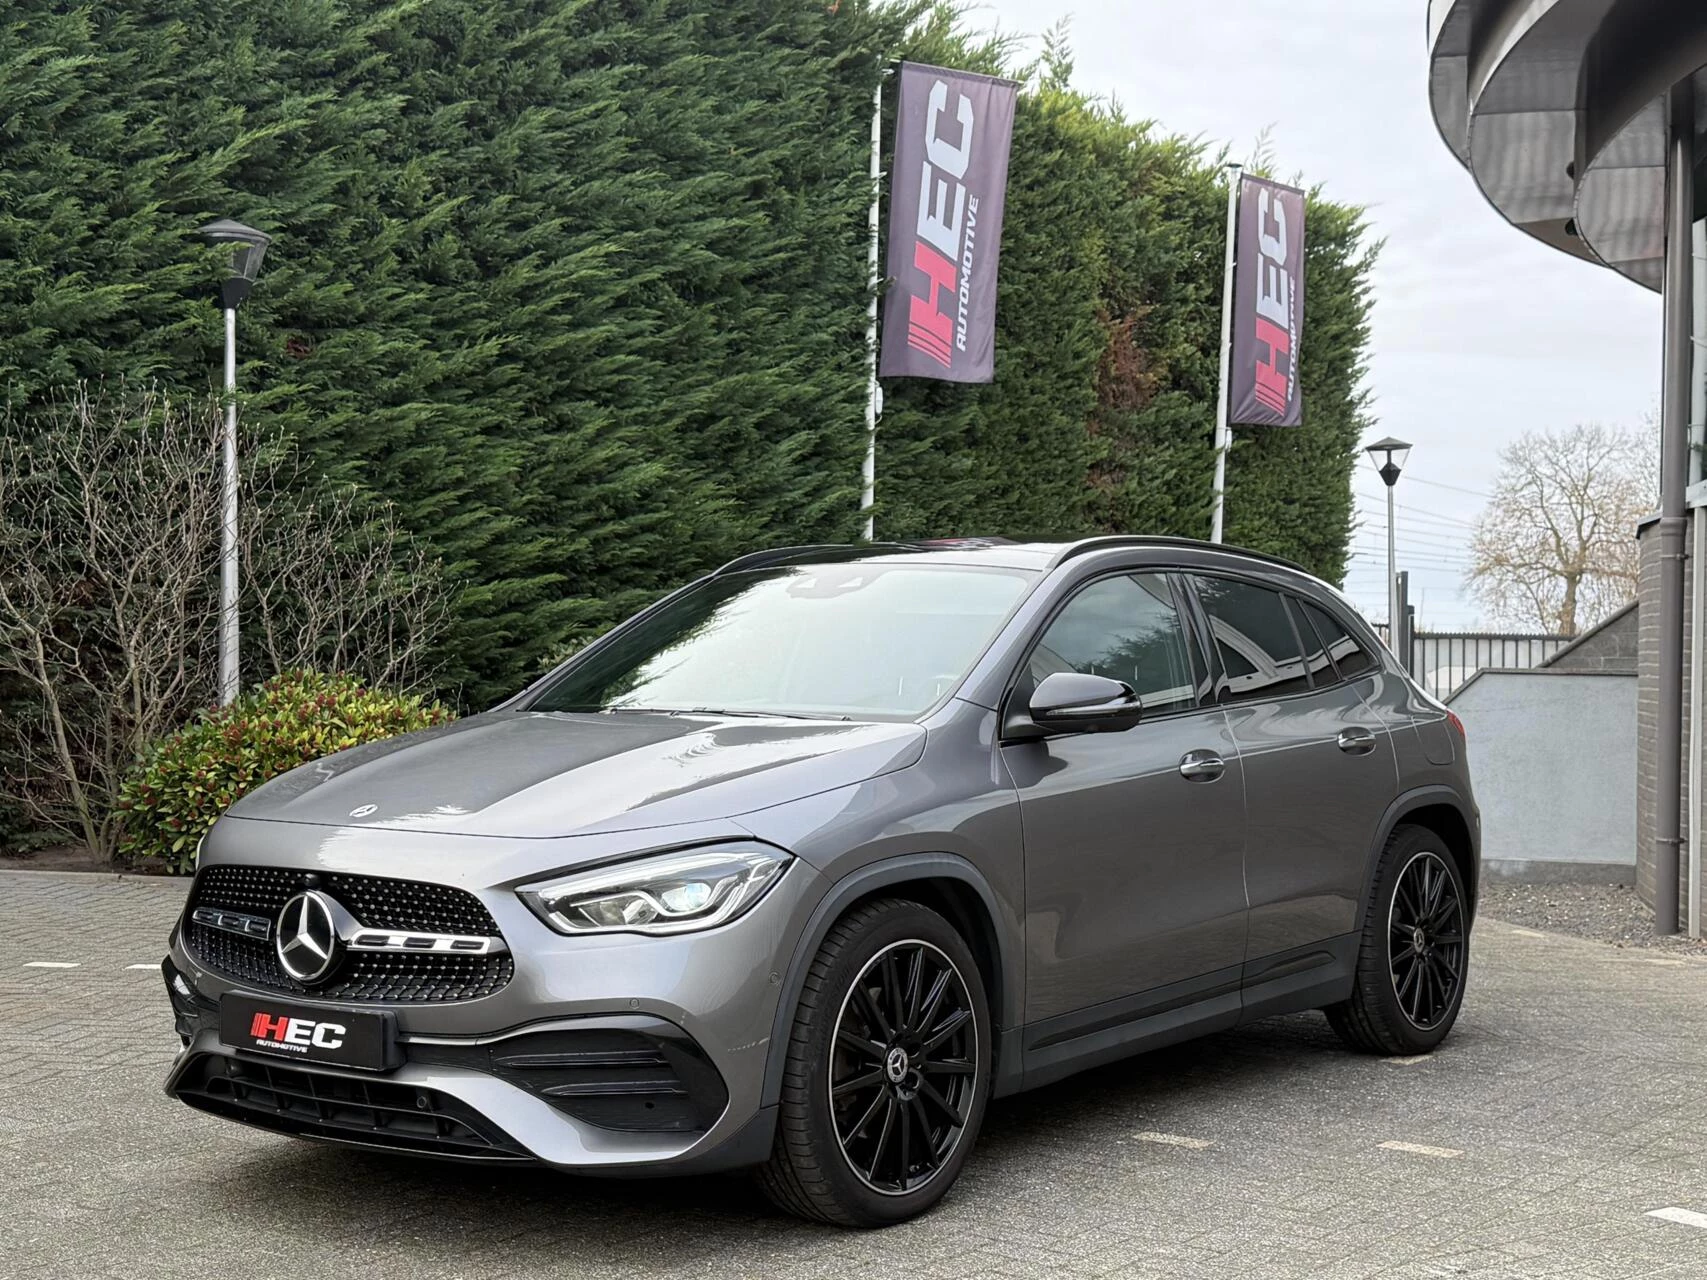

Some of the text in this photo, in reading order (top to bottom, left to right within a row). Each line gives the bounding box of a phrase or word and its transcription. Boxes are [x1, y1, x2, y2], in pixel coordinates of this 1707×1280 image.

[908, 79, 974, 369] HEC
[956, 193, 979, 352] AUTOMOTIVE
[1255, 187, 1289, 417] HEC
[251, 1012, 347, 1049] HEC
[256, 1039, 308, 1053] AUTOMOTIVE
